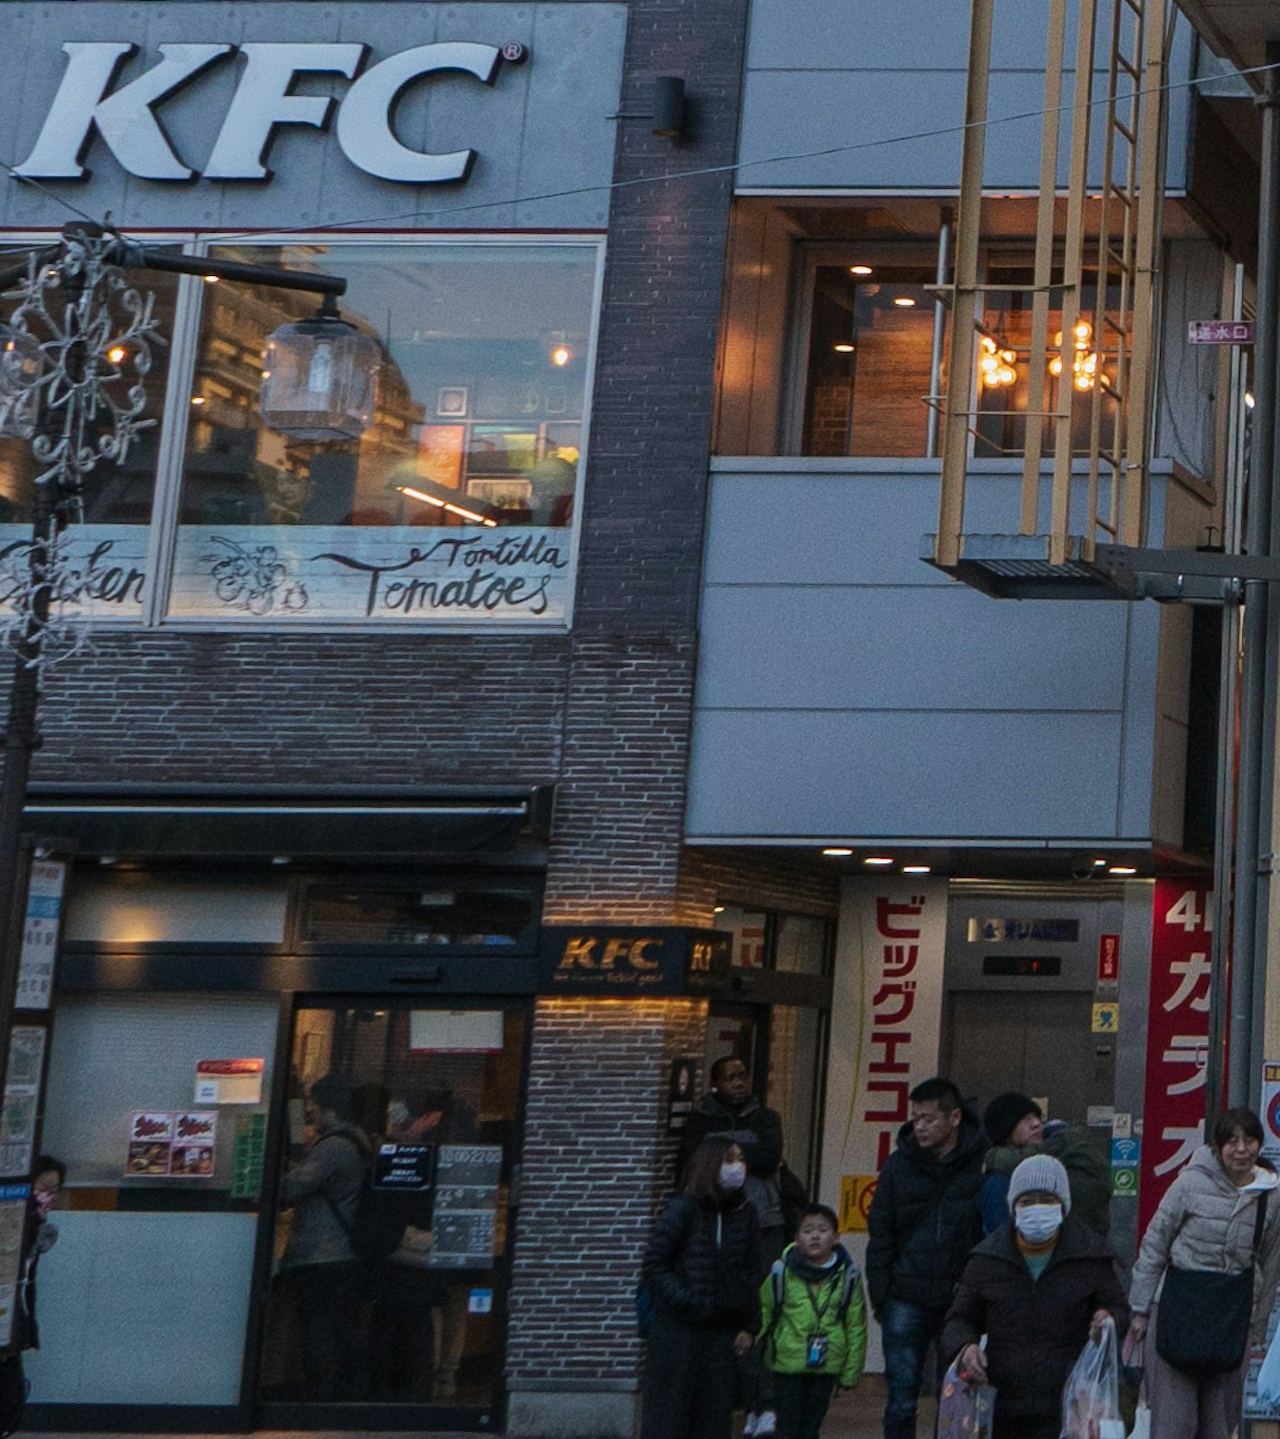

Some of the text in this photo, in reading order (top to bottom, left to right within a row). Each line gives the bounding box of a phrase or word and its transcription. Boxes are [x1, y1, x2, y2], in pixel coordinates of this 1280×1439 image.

[11, 40, 503, 182] KFC
[365, 568, 550, 618] Tomatoes
[558, 935, 665, 971] KFC
[864, 895, 925, 1172] ビッグエコー
